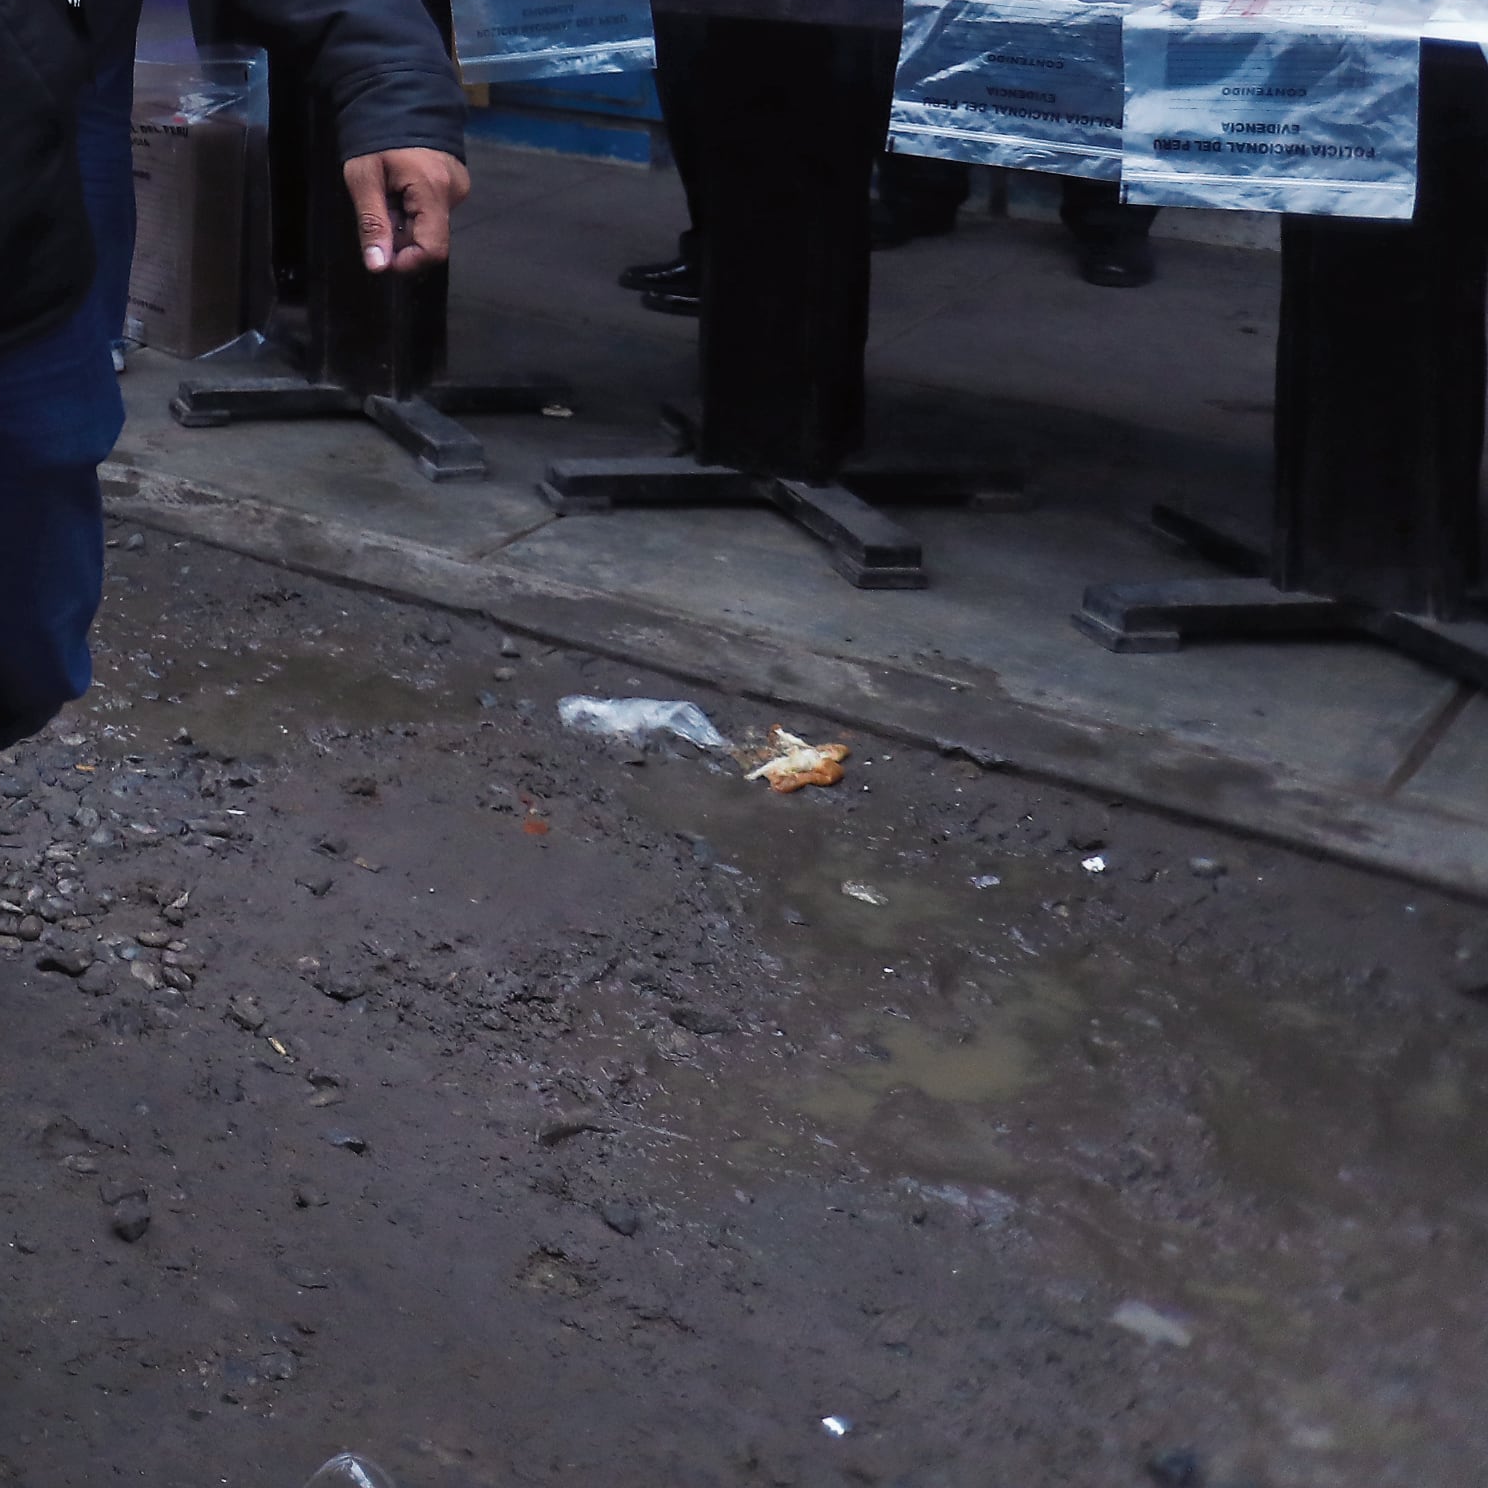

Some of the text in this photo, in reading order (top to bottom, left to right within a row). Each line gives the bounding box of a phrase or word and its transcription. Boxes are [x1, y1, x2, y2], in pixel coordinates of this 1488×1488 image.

[986, 54, 1065, 69] CONTENIDO
[986, 86, 1056, 104] EVIDENCIA
[1222, 87, 1307, 98] CONTENIDO
[922, 96, 958, 110] PERU
[965, 102, 986, 114] DEL
[992, 104, 1060, 123] NACIONAL
[1221, 122, 1300, 135] EVIDENCIA
[1153, 139, 1376, 160] POLICIA NACIONAL DEL PERU
